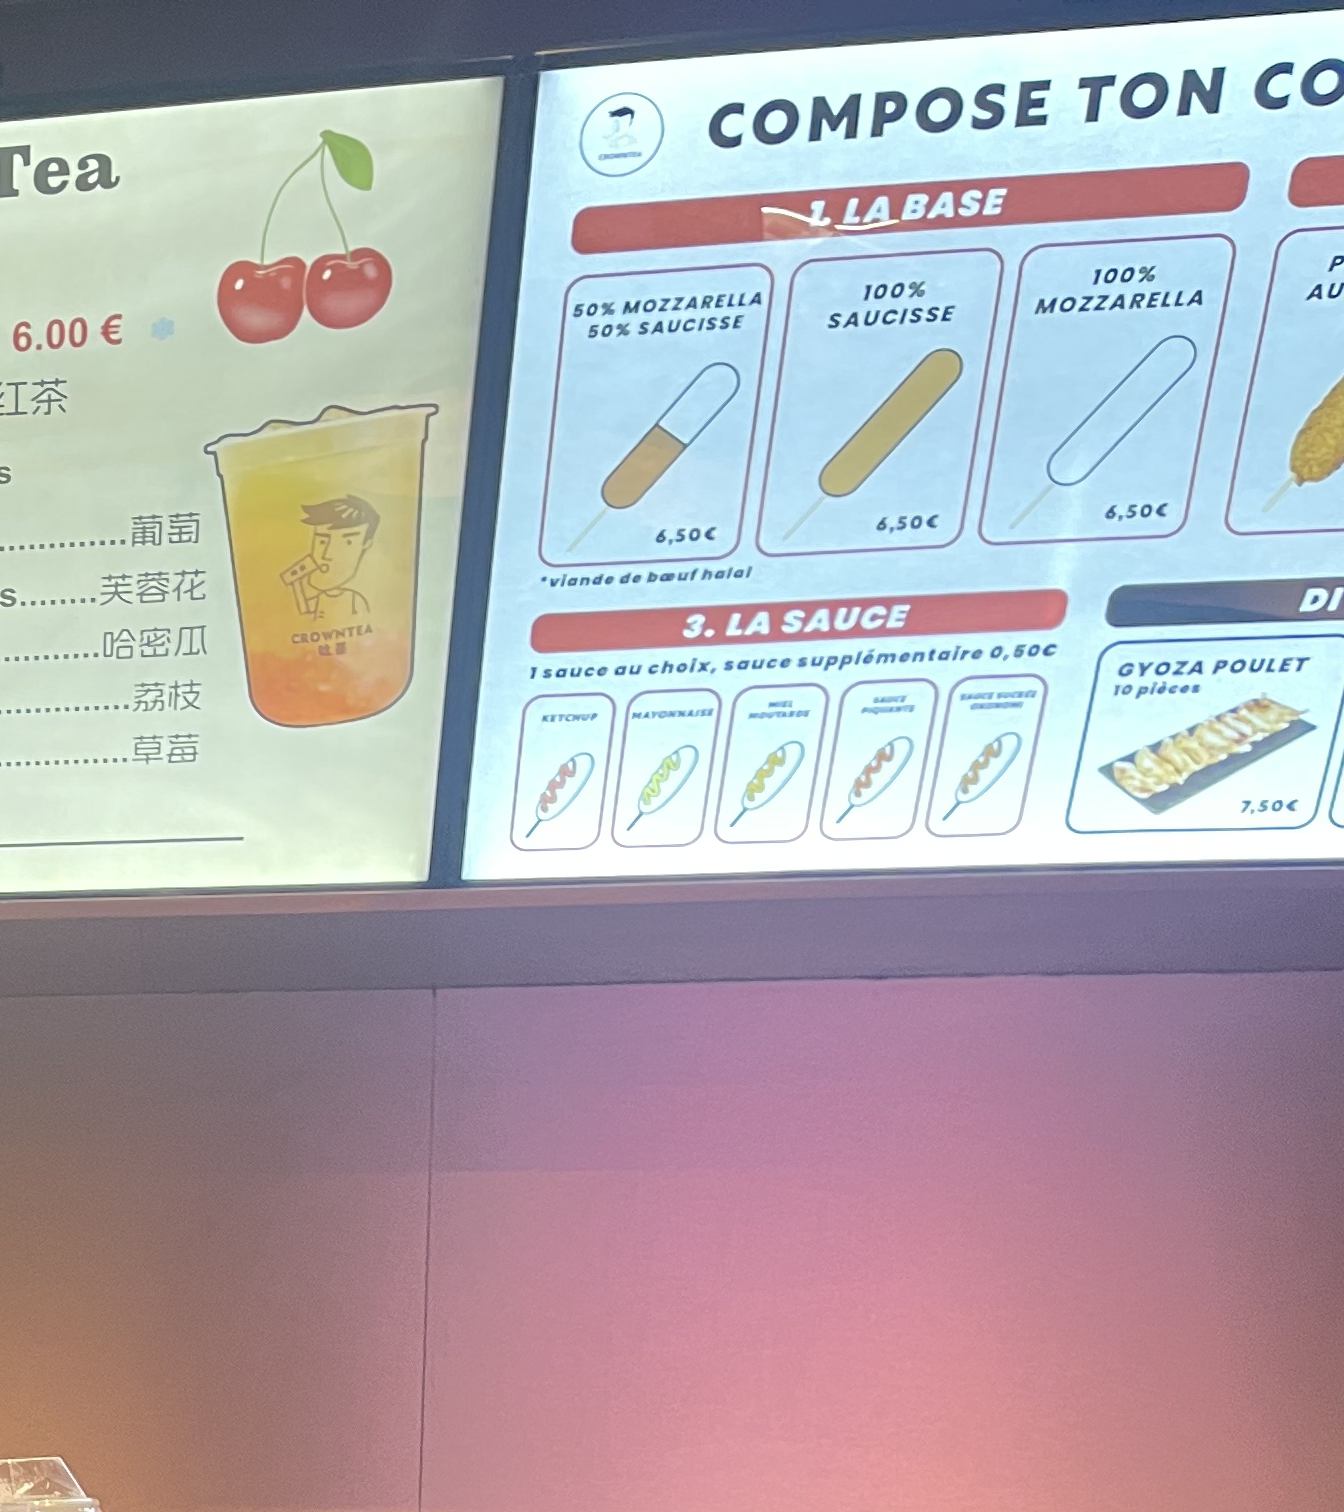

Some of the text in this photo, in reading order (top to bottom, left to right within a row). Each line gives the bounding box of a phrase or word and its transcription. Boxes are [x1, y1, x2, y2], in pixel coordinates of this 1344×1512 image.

[708, 77, 1052, 150] COMPOSE
[1077, 66, 1226, 123] TON
[843, 195, 891, 225] LA
[901, 187, 1008, 222] BASE
[1092, 265, 1156, 285] 100%
[573, 291, 763, 319] 50% MOZZARELLA
[863, 281, 925, 302] 100%
[1034, 289, 1204, 315] MOZZARELLA
[12, 316, 88, 352] 6.00
[100, 313, 123, 346] €
[588, 314, 745, 339] 50% SAUCISSE
[827, 303, 956, 330] SAUCISSE
[131, 511, 201, 548] 葡萄
[99, 569, 207, 606] 芙蓉花
[620, 572, 640, 585] de
[701, 566, 753, 581] halal
[682, 604, 911, 638] 3. LA SAUCE
[102, 624, 207, 660] 哈密瓜
[543, 667, 608, 679] sauce
[614, 664, 642, 676] au
[724, 657, 792, 671] sauce
[798, 646, 983, 671] supplémentaire
[1118, 657, 1310, 677] GYOZA POULET
[132, 679, 202, 712] 荔枝
[132, 733, 200, 765] 草莓
